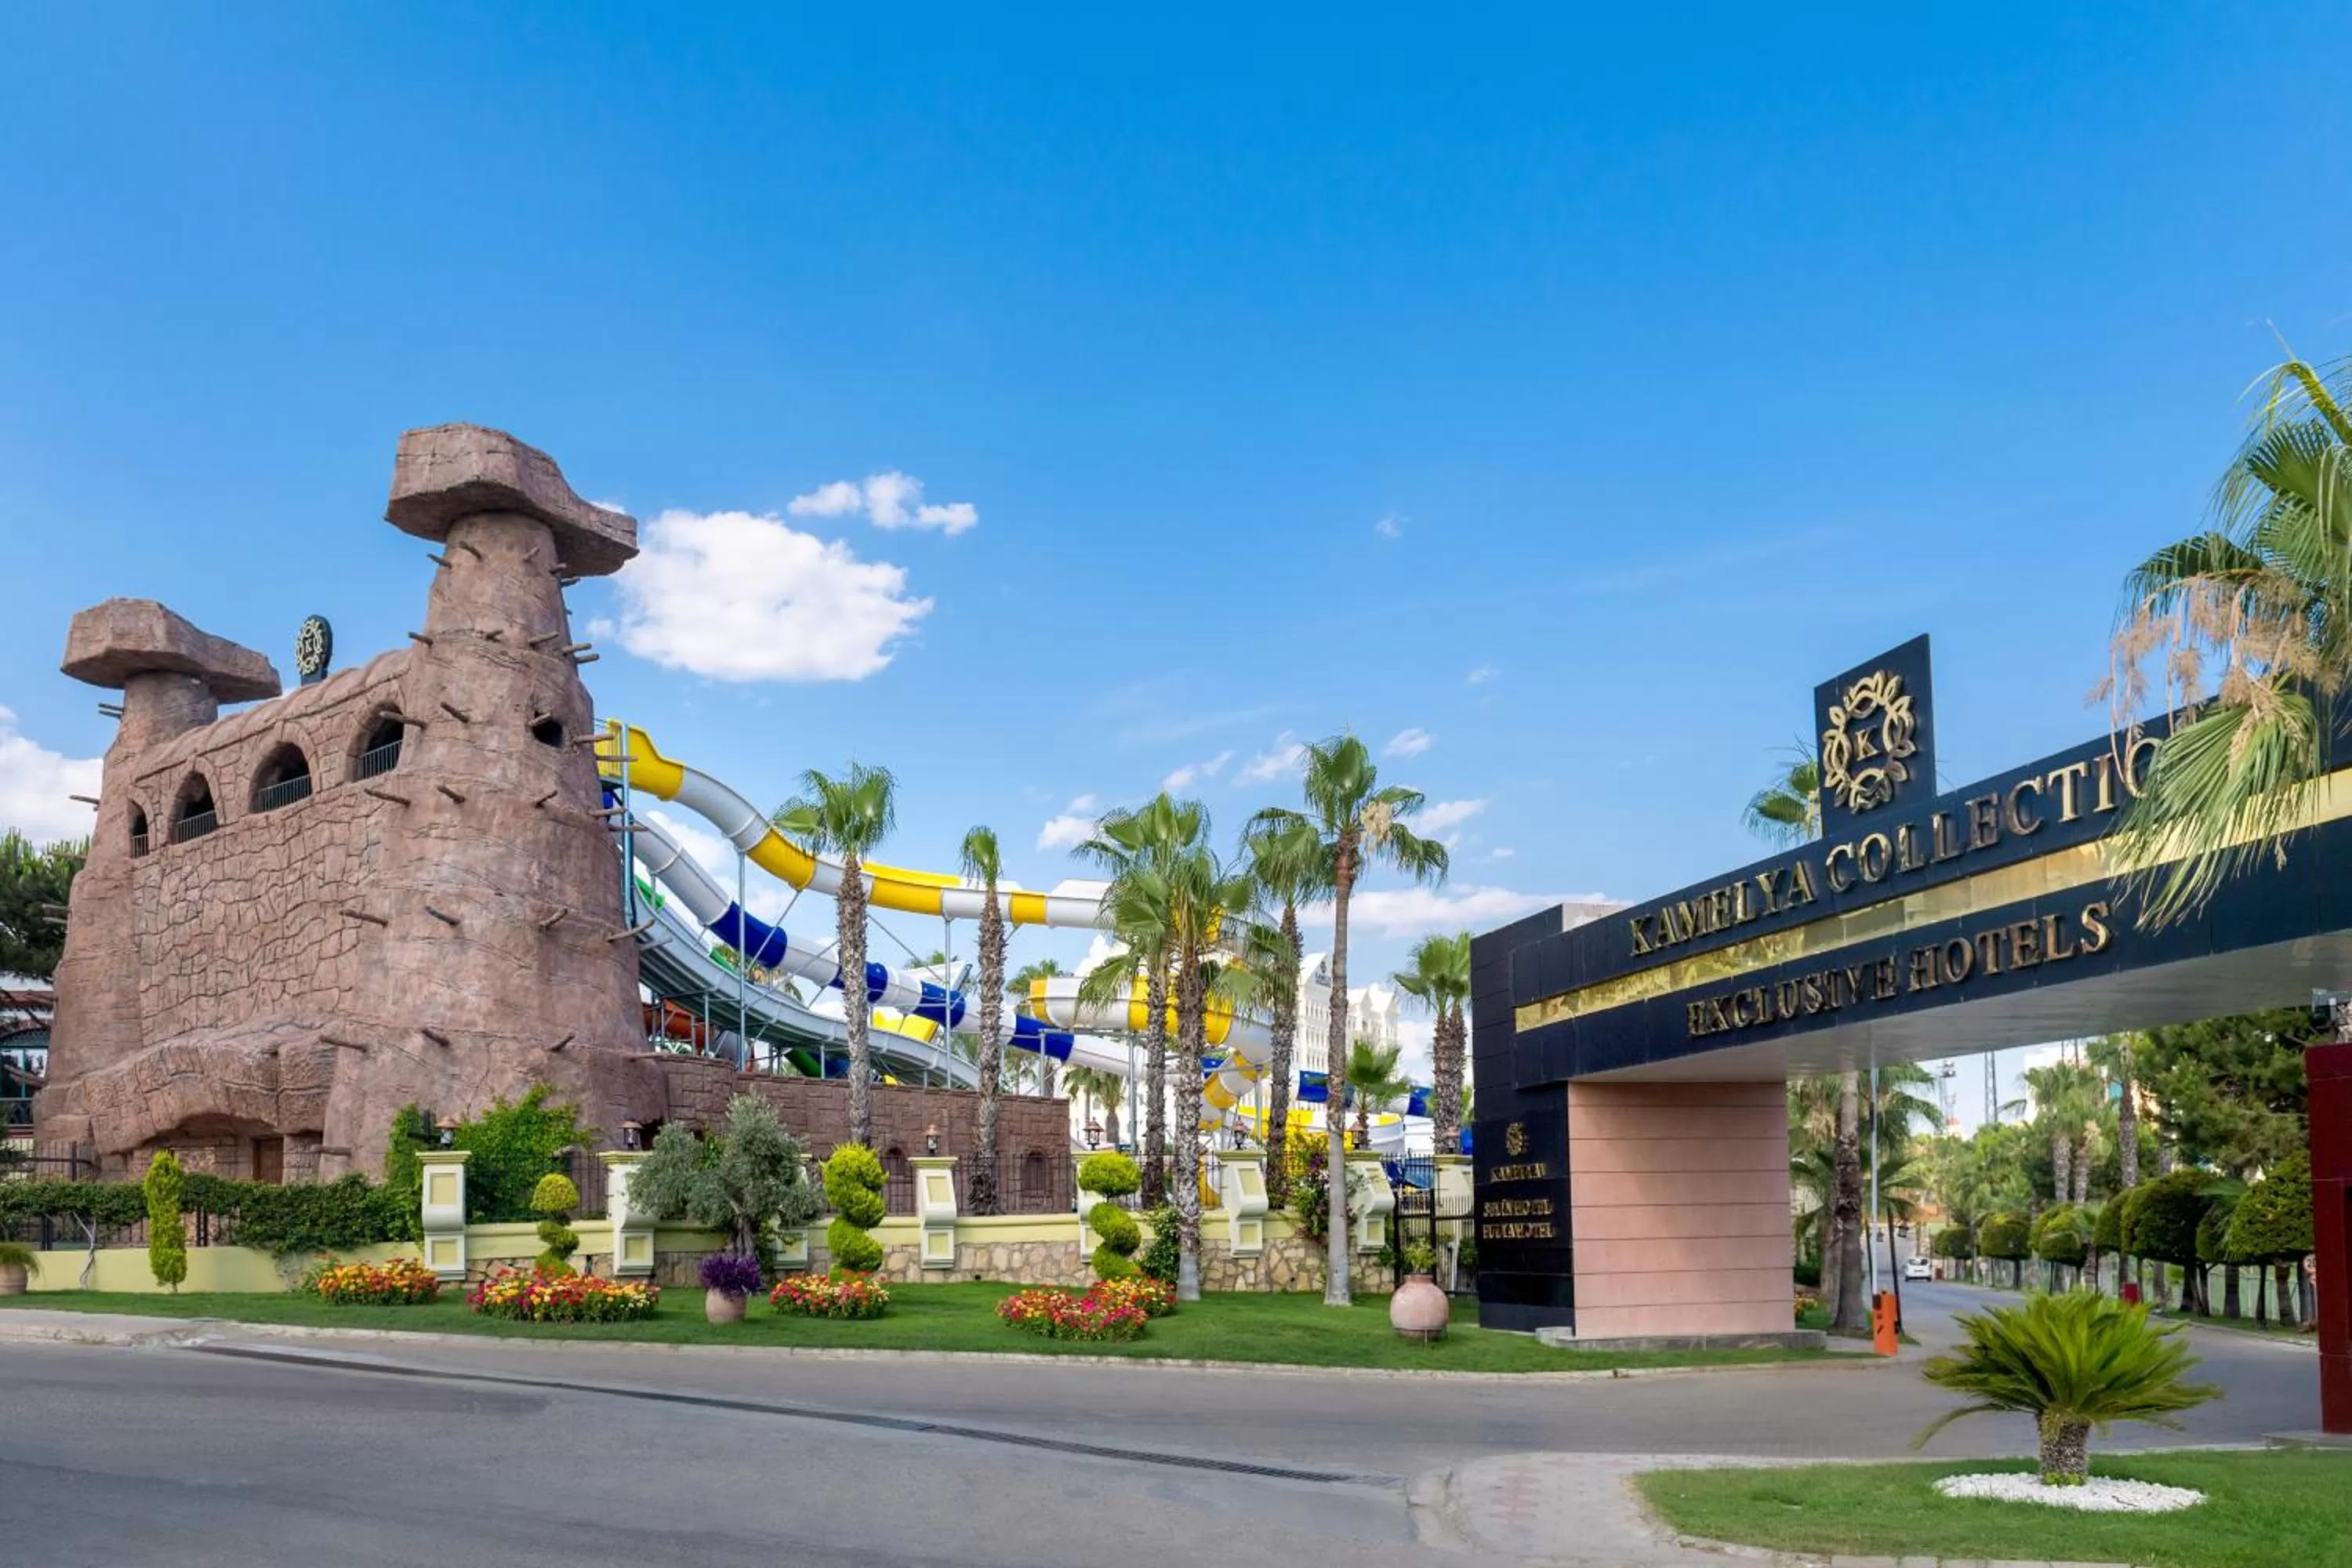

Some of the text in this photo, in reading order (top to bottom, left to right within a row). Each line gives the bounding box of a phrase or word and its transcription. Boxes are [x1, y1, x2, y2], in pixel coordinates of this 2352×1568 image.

[1853, 726, 1880, 761] K
[1630, 737, 2163, 957] KAMELYA COLLECTIO
[1686, 901, 2111, 1036] EXCLUSIVE HOTELS
